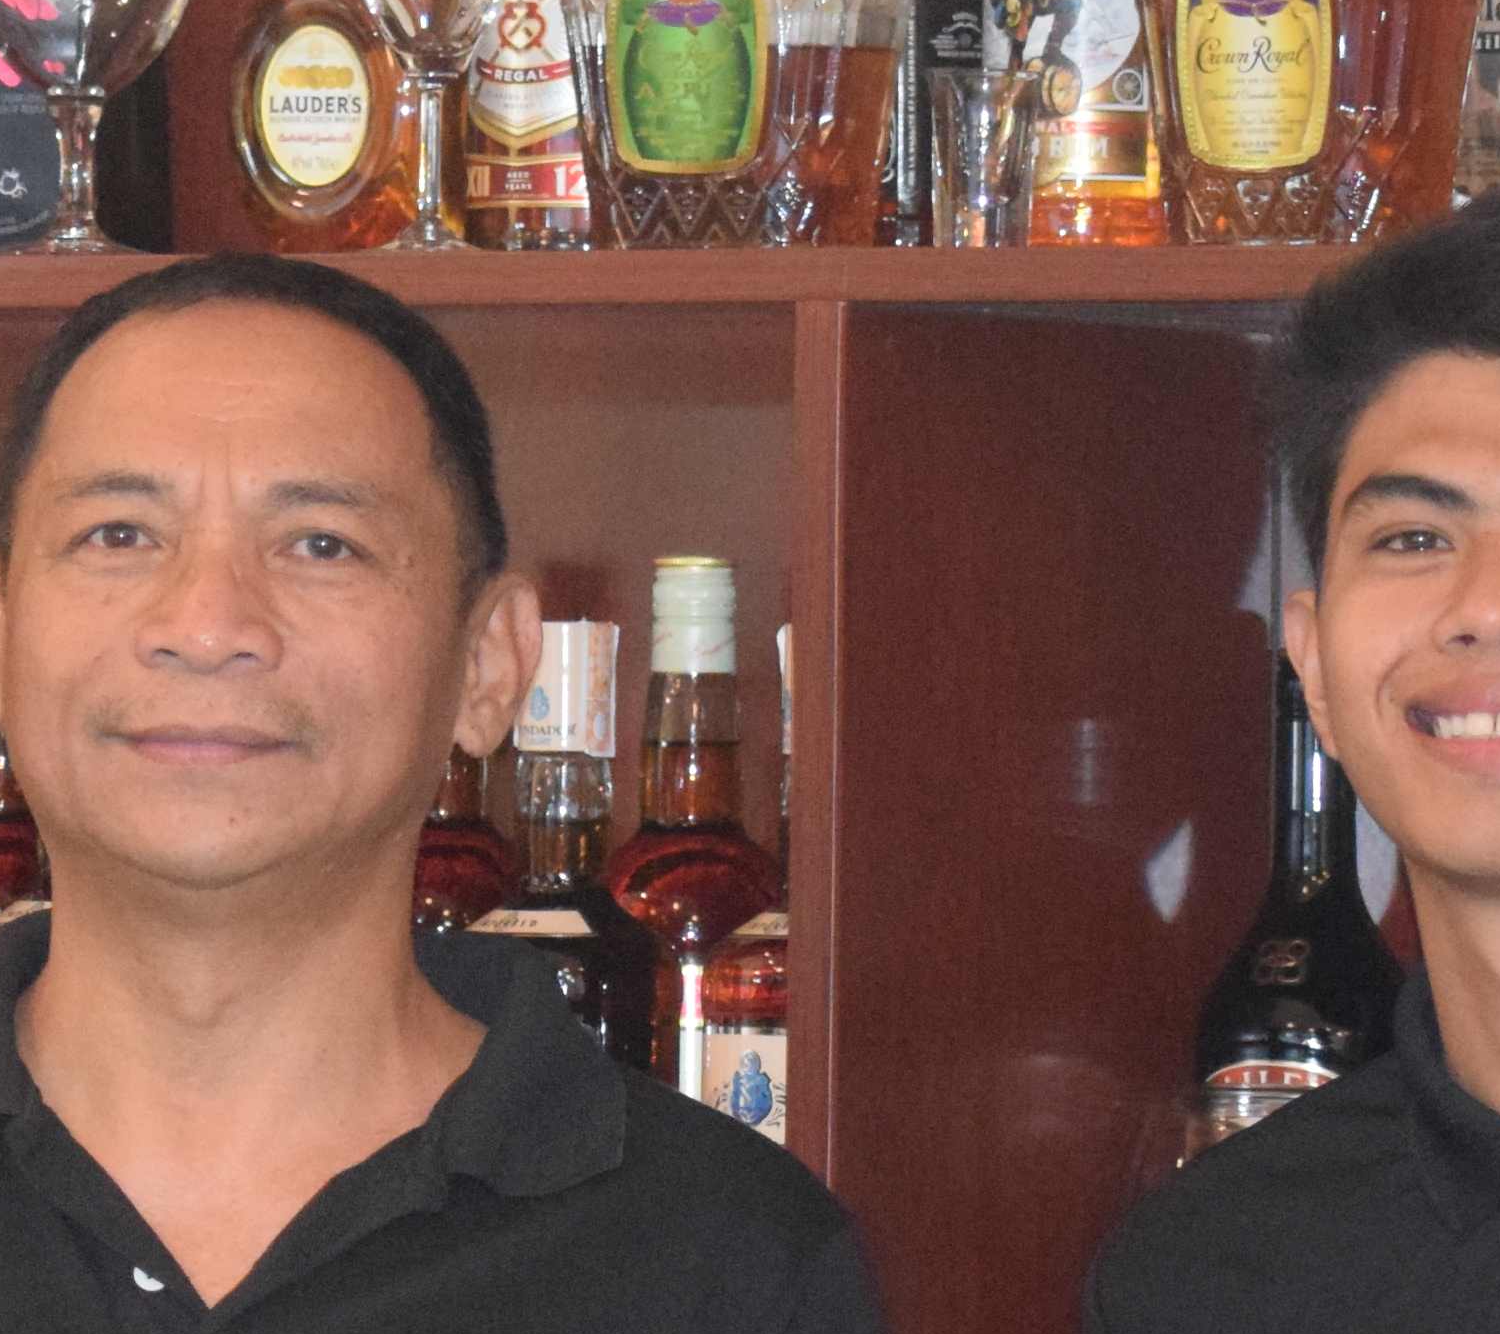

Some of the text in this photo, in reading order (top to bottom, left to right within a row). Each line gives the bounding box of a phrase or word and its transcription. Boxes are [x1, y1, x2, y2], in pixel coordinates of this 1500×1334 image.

[1196, 36, 1309, 74] Crown Royal
[493, 68, 549, 83] REGAL
[270, 95, 363, 114] LAUDER'S
[553, 163, 588, 197] 12
